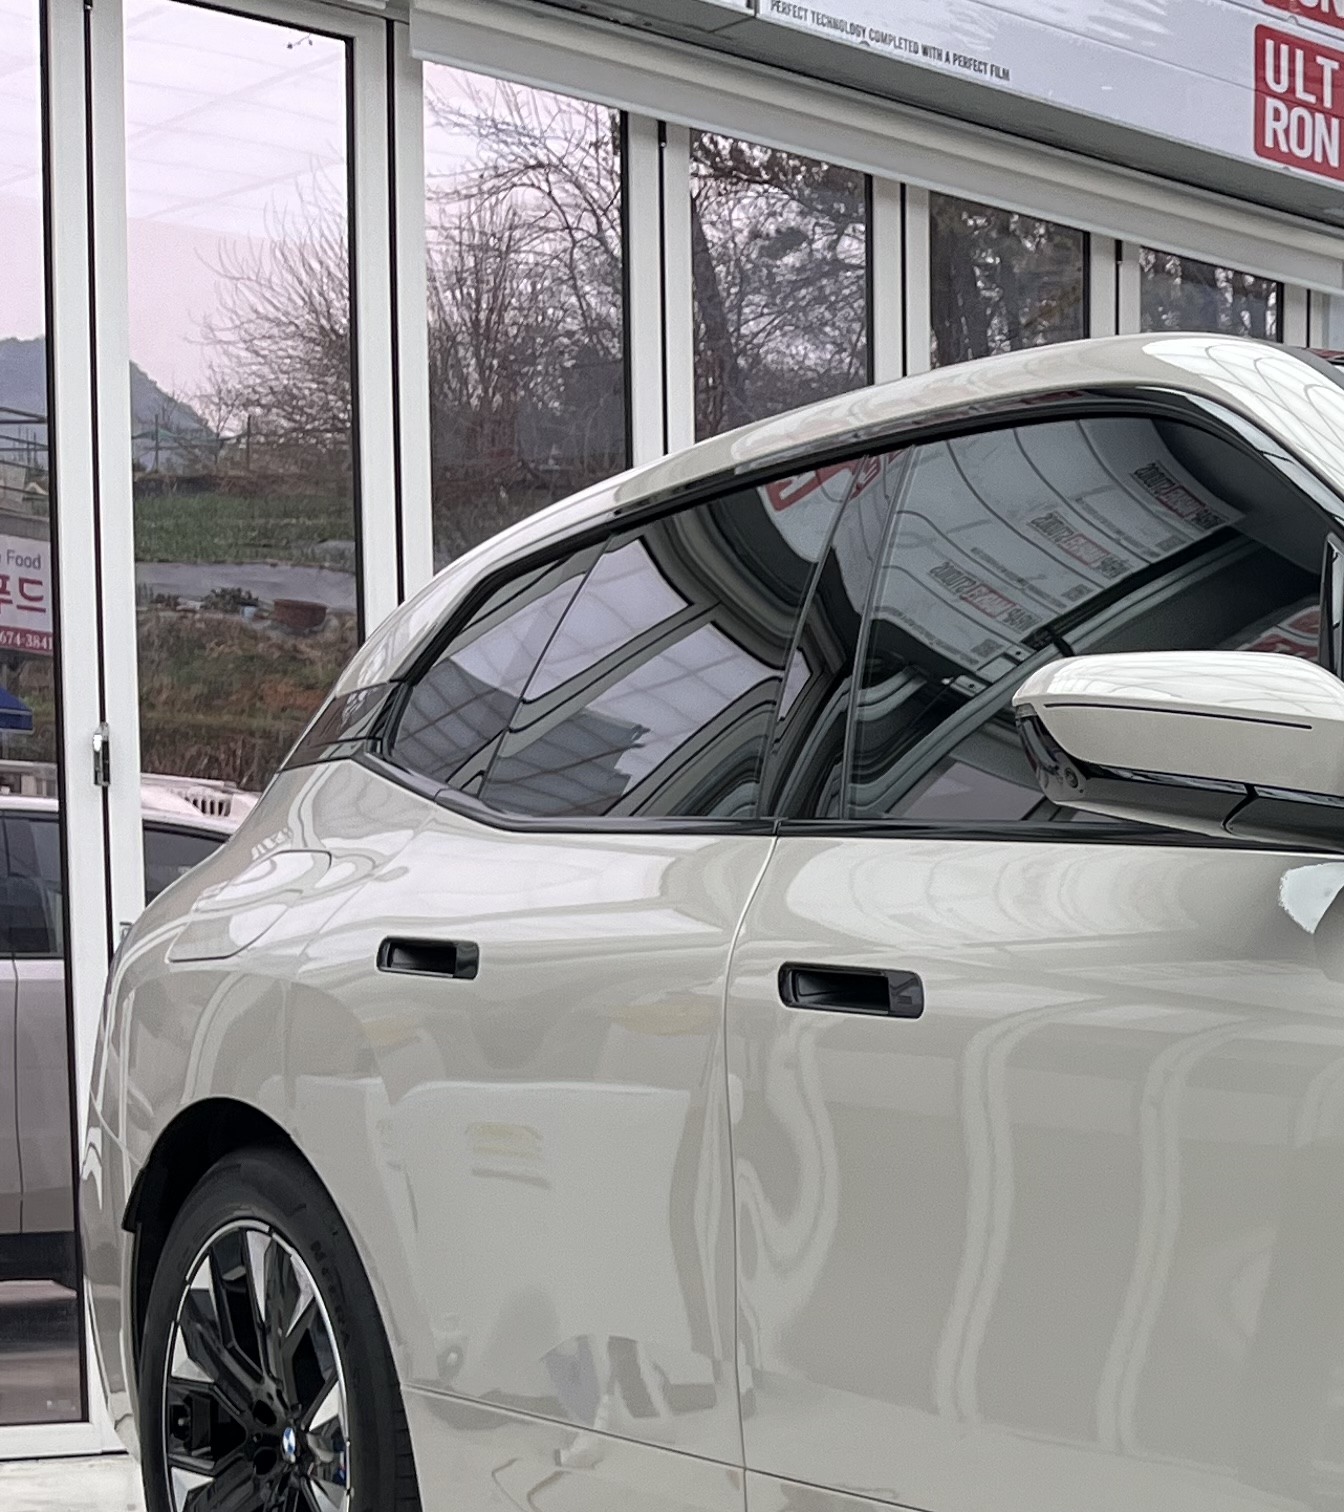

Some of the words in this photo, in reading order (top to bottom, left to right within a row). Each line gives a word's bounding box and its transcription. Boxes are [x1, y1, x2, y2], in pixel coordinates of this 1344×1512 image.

[770, 0, 808, 22] PERFECT
[810, 11, 868, 40] TECHNOLOGY
[868, 27, 920, 56] COMPLETED
[921, 40, 943, 61] WITH
[944, 47, 951, 65] A
[951, 52, 989, 76] PERFECT
[989, 60, 1011, 81] FILM
[1264, 39, 1341, 110] ULT
[1264, 96, 1341, 170] RON
[6, 549, 42, 570] Food
